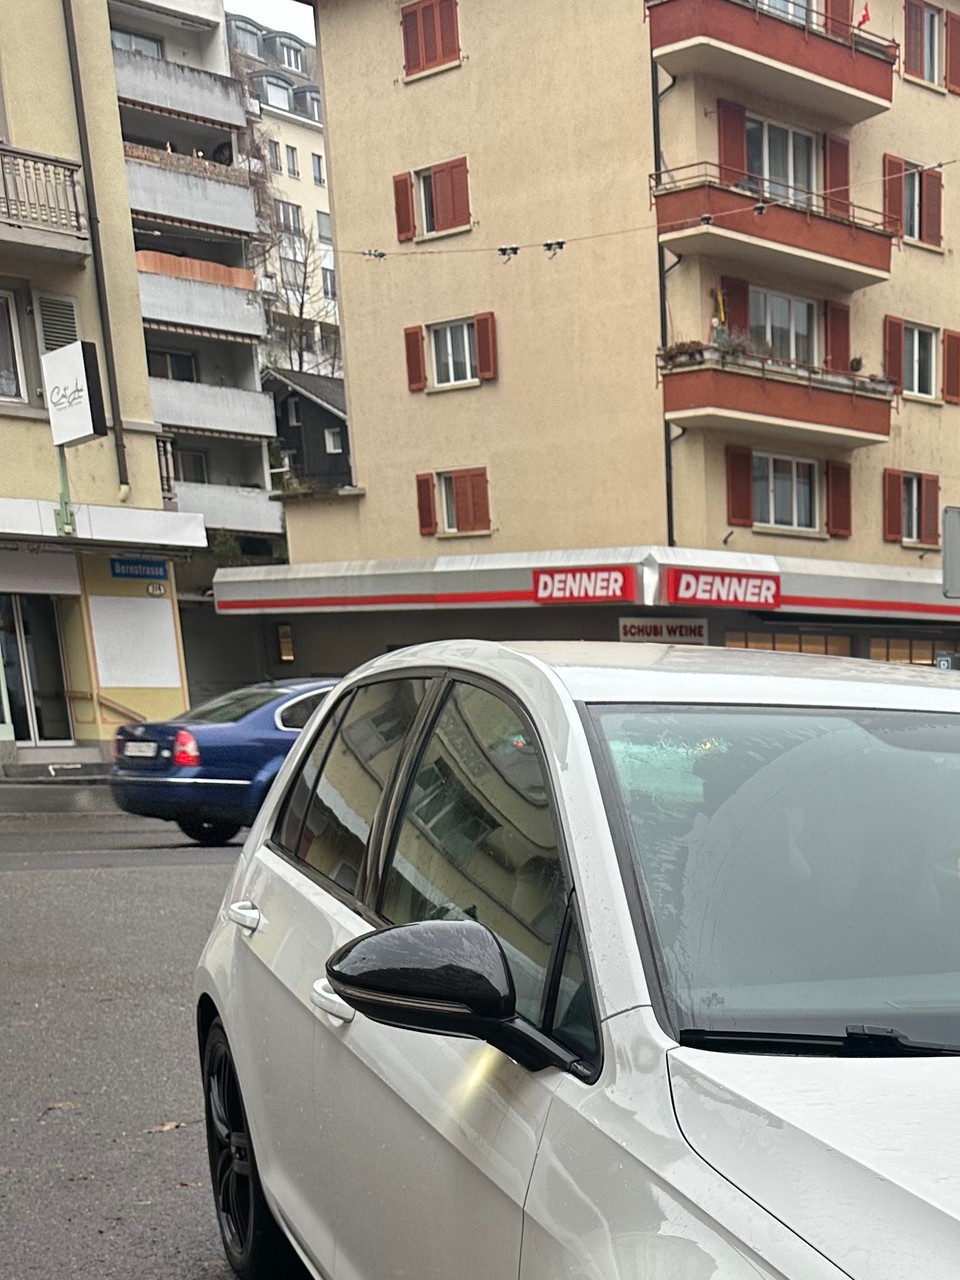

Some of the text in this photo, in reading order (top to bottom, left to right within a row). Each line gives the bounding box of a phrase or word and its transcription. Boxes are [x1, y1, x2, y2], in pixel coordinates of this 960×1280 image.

[536, 571, 625, 599] DENNER
[677, 572, 778, 604] DENNER
[621, 623, 704, 637] SCHUBI WEINE
